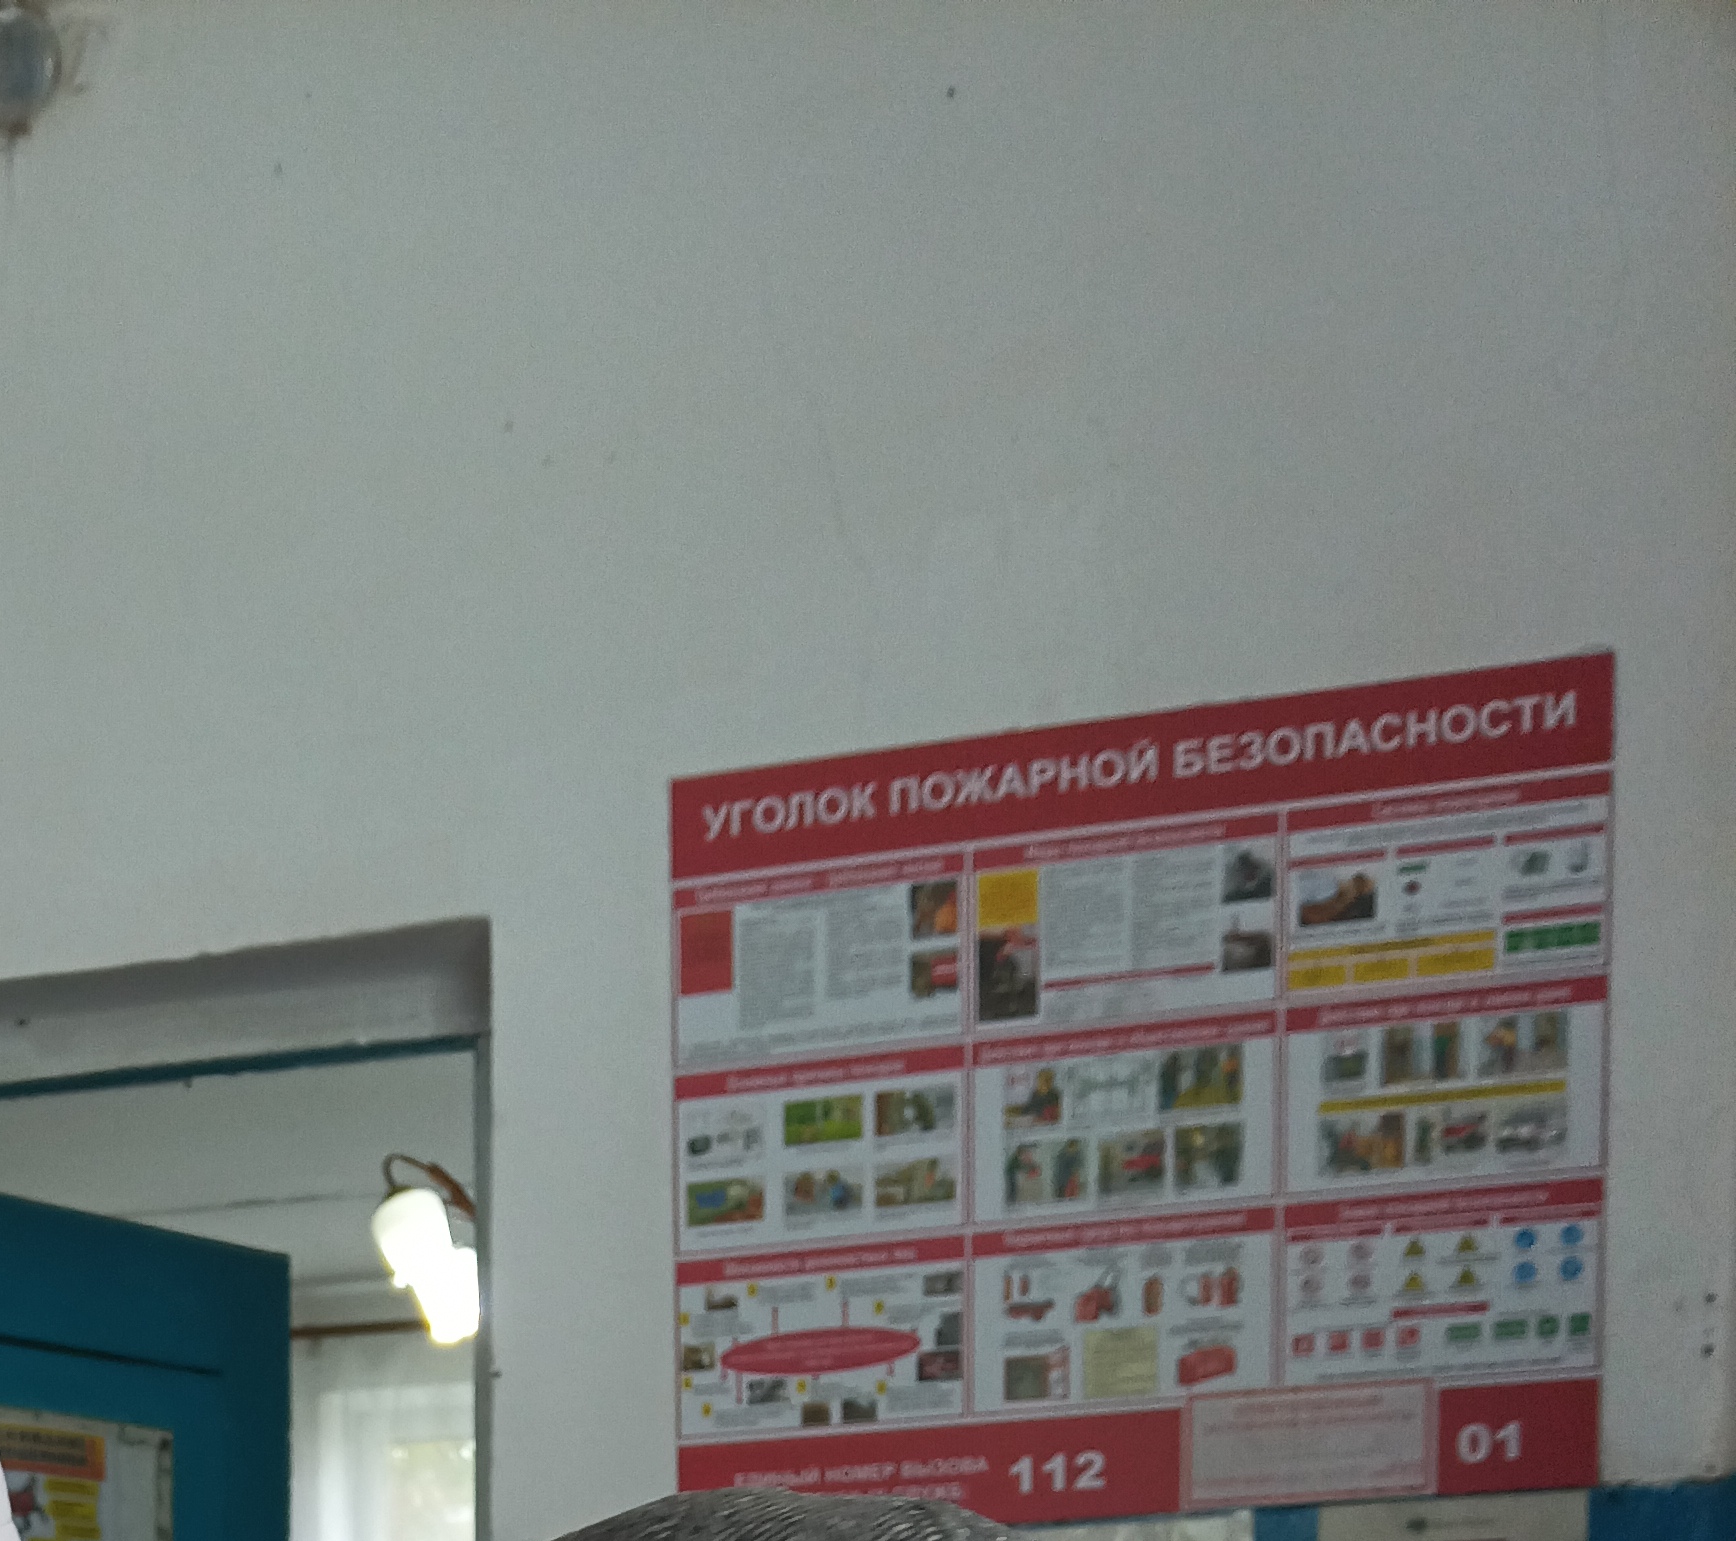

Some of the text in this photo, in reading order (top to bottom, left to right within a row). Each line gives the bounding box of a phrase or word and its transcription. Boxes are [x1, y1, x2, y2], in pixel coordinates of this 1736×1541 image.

[703, 690, 1578, 842] УГОЛОК ПОЖАРНОЙ БЕЗОПАСНОСТИ
[1457, 1420, 1522, 1464] 01
[1008, 1449, 1106, 1495] 112
